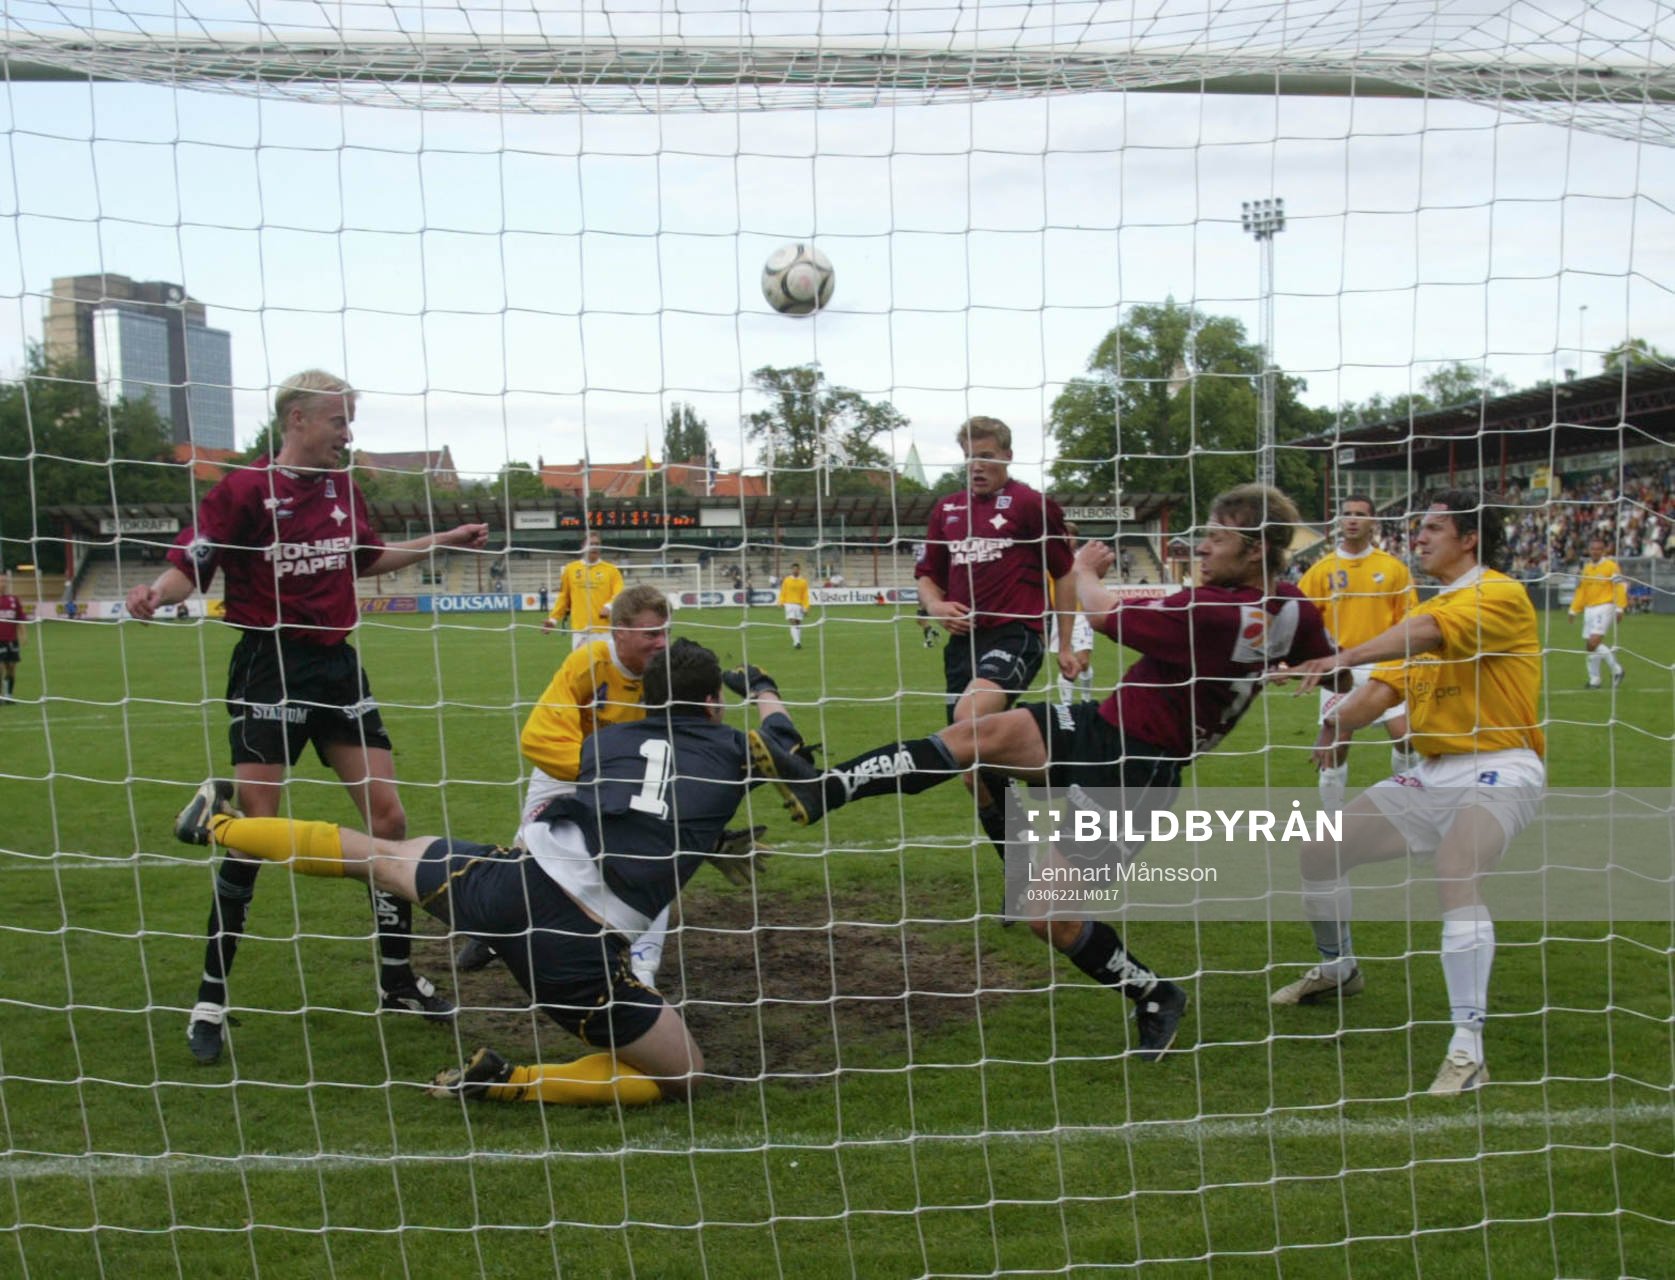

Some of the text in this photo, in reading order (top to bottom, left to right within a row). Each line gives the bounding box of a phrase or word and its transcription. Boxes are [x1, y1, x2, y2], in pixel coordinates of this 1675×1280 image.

[1064, 507, 1130, 518] IHLBORGS
[432, 595, 510, 611] FOLKSAM
[629, 738, 672, 820] 1
